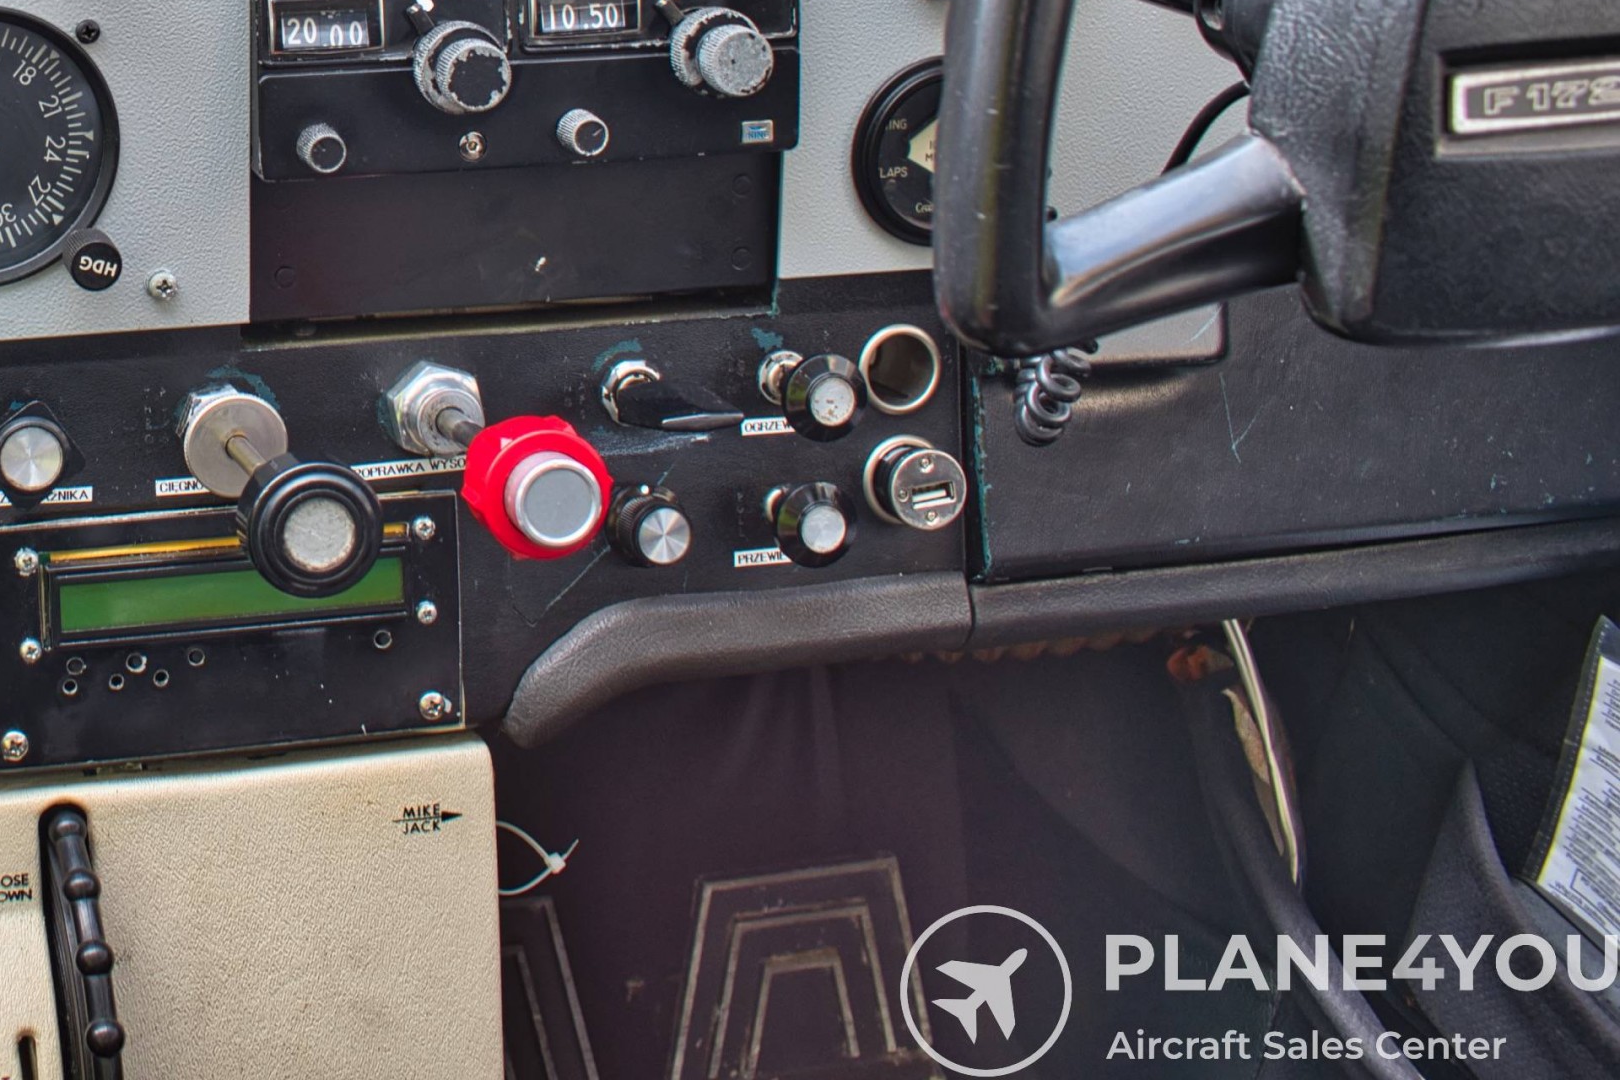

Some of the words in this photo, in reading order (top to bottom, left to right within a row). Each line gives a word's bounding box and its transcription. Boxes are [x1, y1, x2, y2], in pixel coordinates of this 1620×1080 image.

[288, 17, 317, 44] 20
[79, 256, 117, 277] HDG
[403, 803, 440, 819] MIKE
[403, 821, 441, 835] JACK
